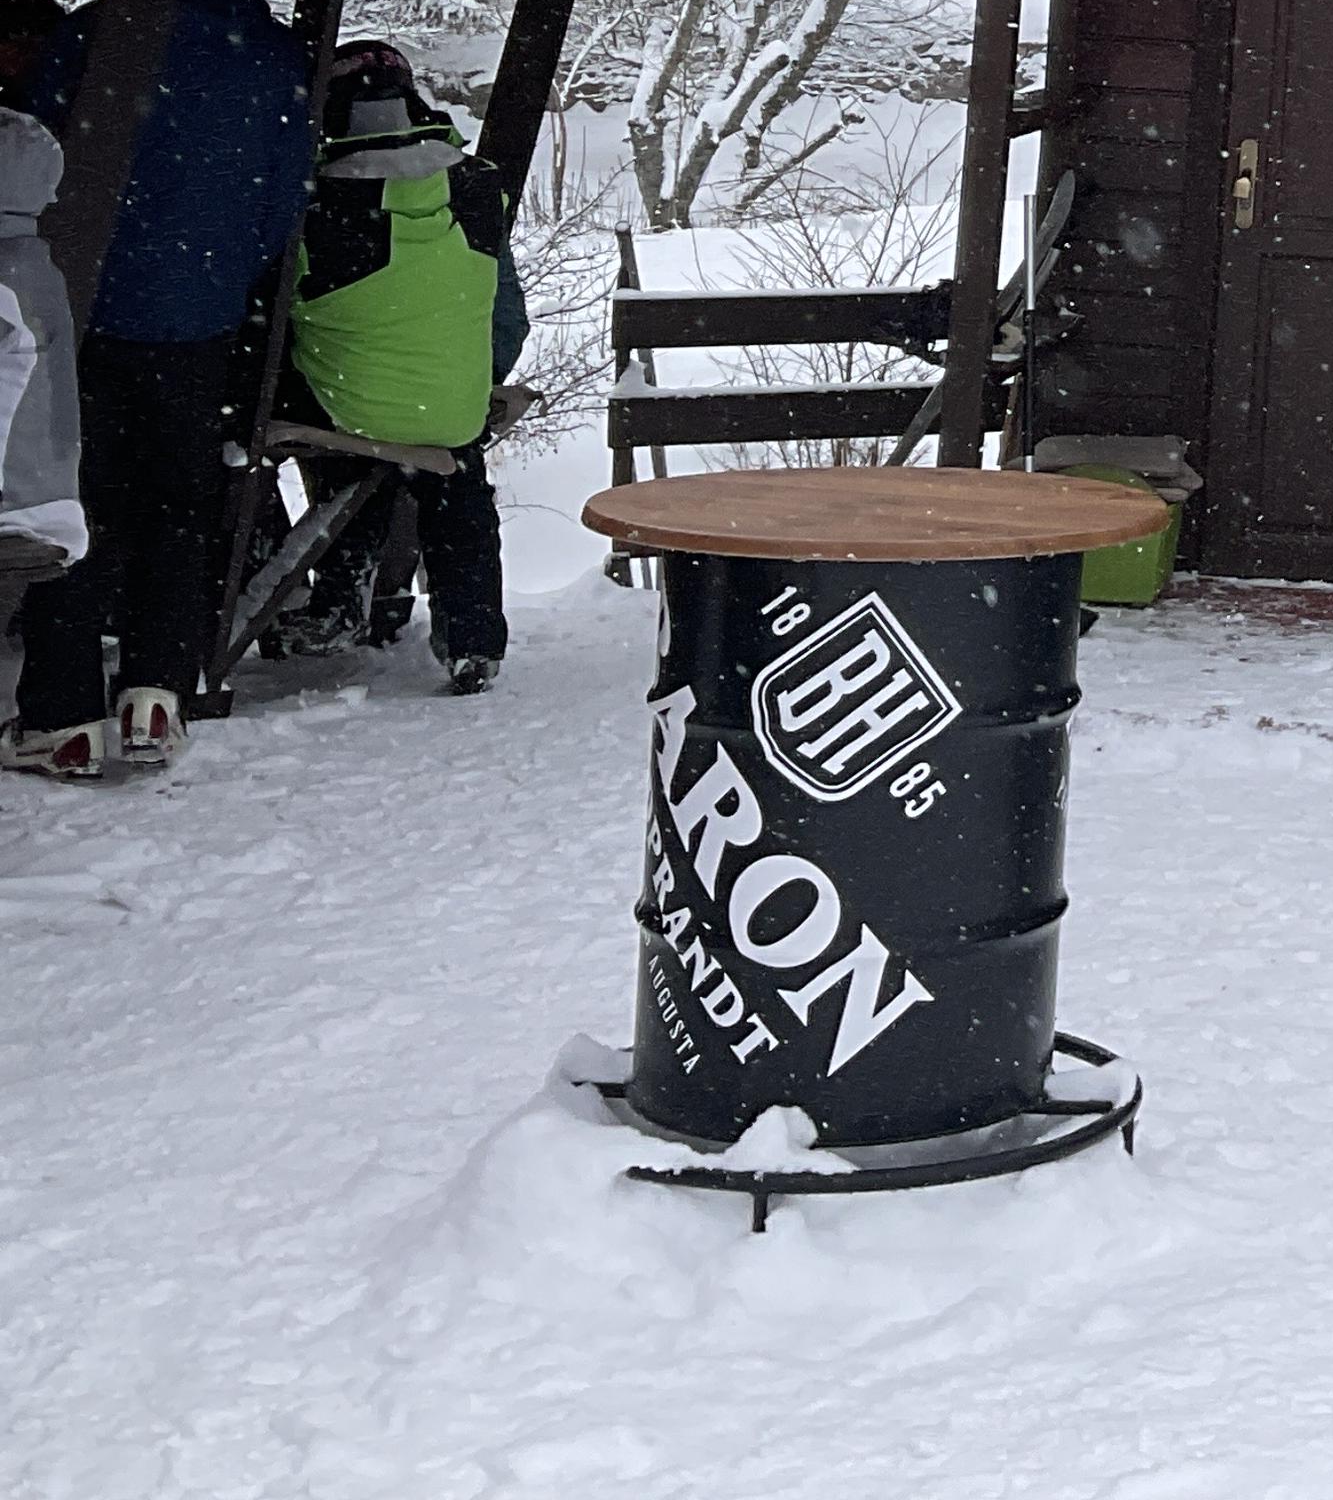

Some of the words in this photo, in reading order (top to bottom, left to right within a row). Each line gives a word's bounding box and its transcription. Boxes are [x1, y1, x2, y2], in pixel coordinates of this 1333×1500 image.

[760, 585, 811, 637] 18
[776, 627, 931, 776] BH
[646, 605, 936, 1078] ARON
[889, 761, 947, 819] 85
[644, 790, 780, 1066] PRANDT
[647, 954, 702, 1076] AUGUSTA
